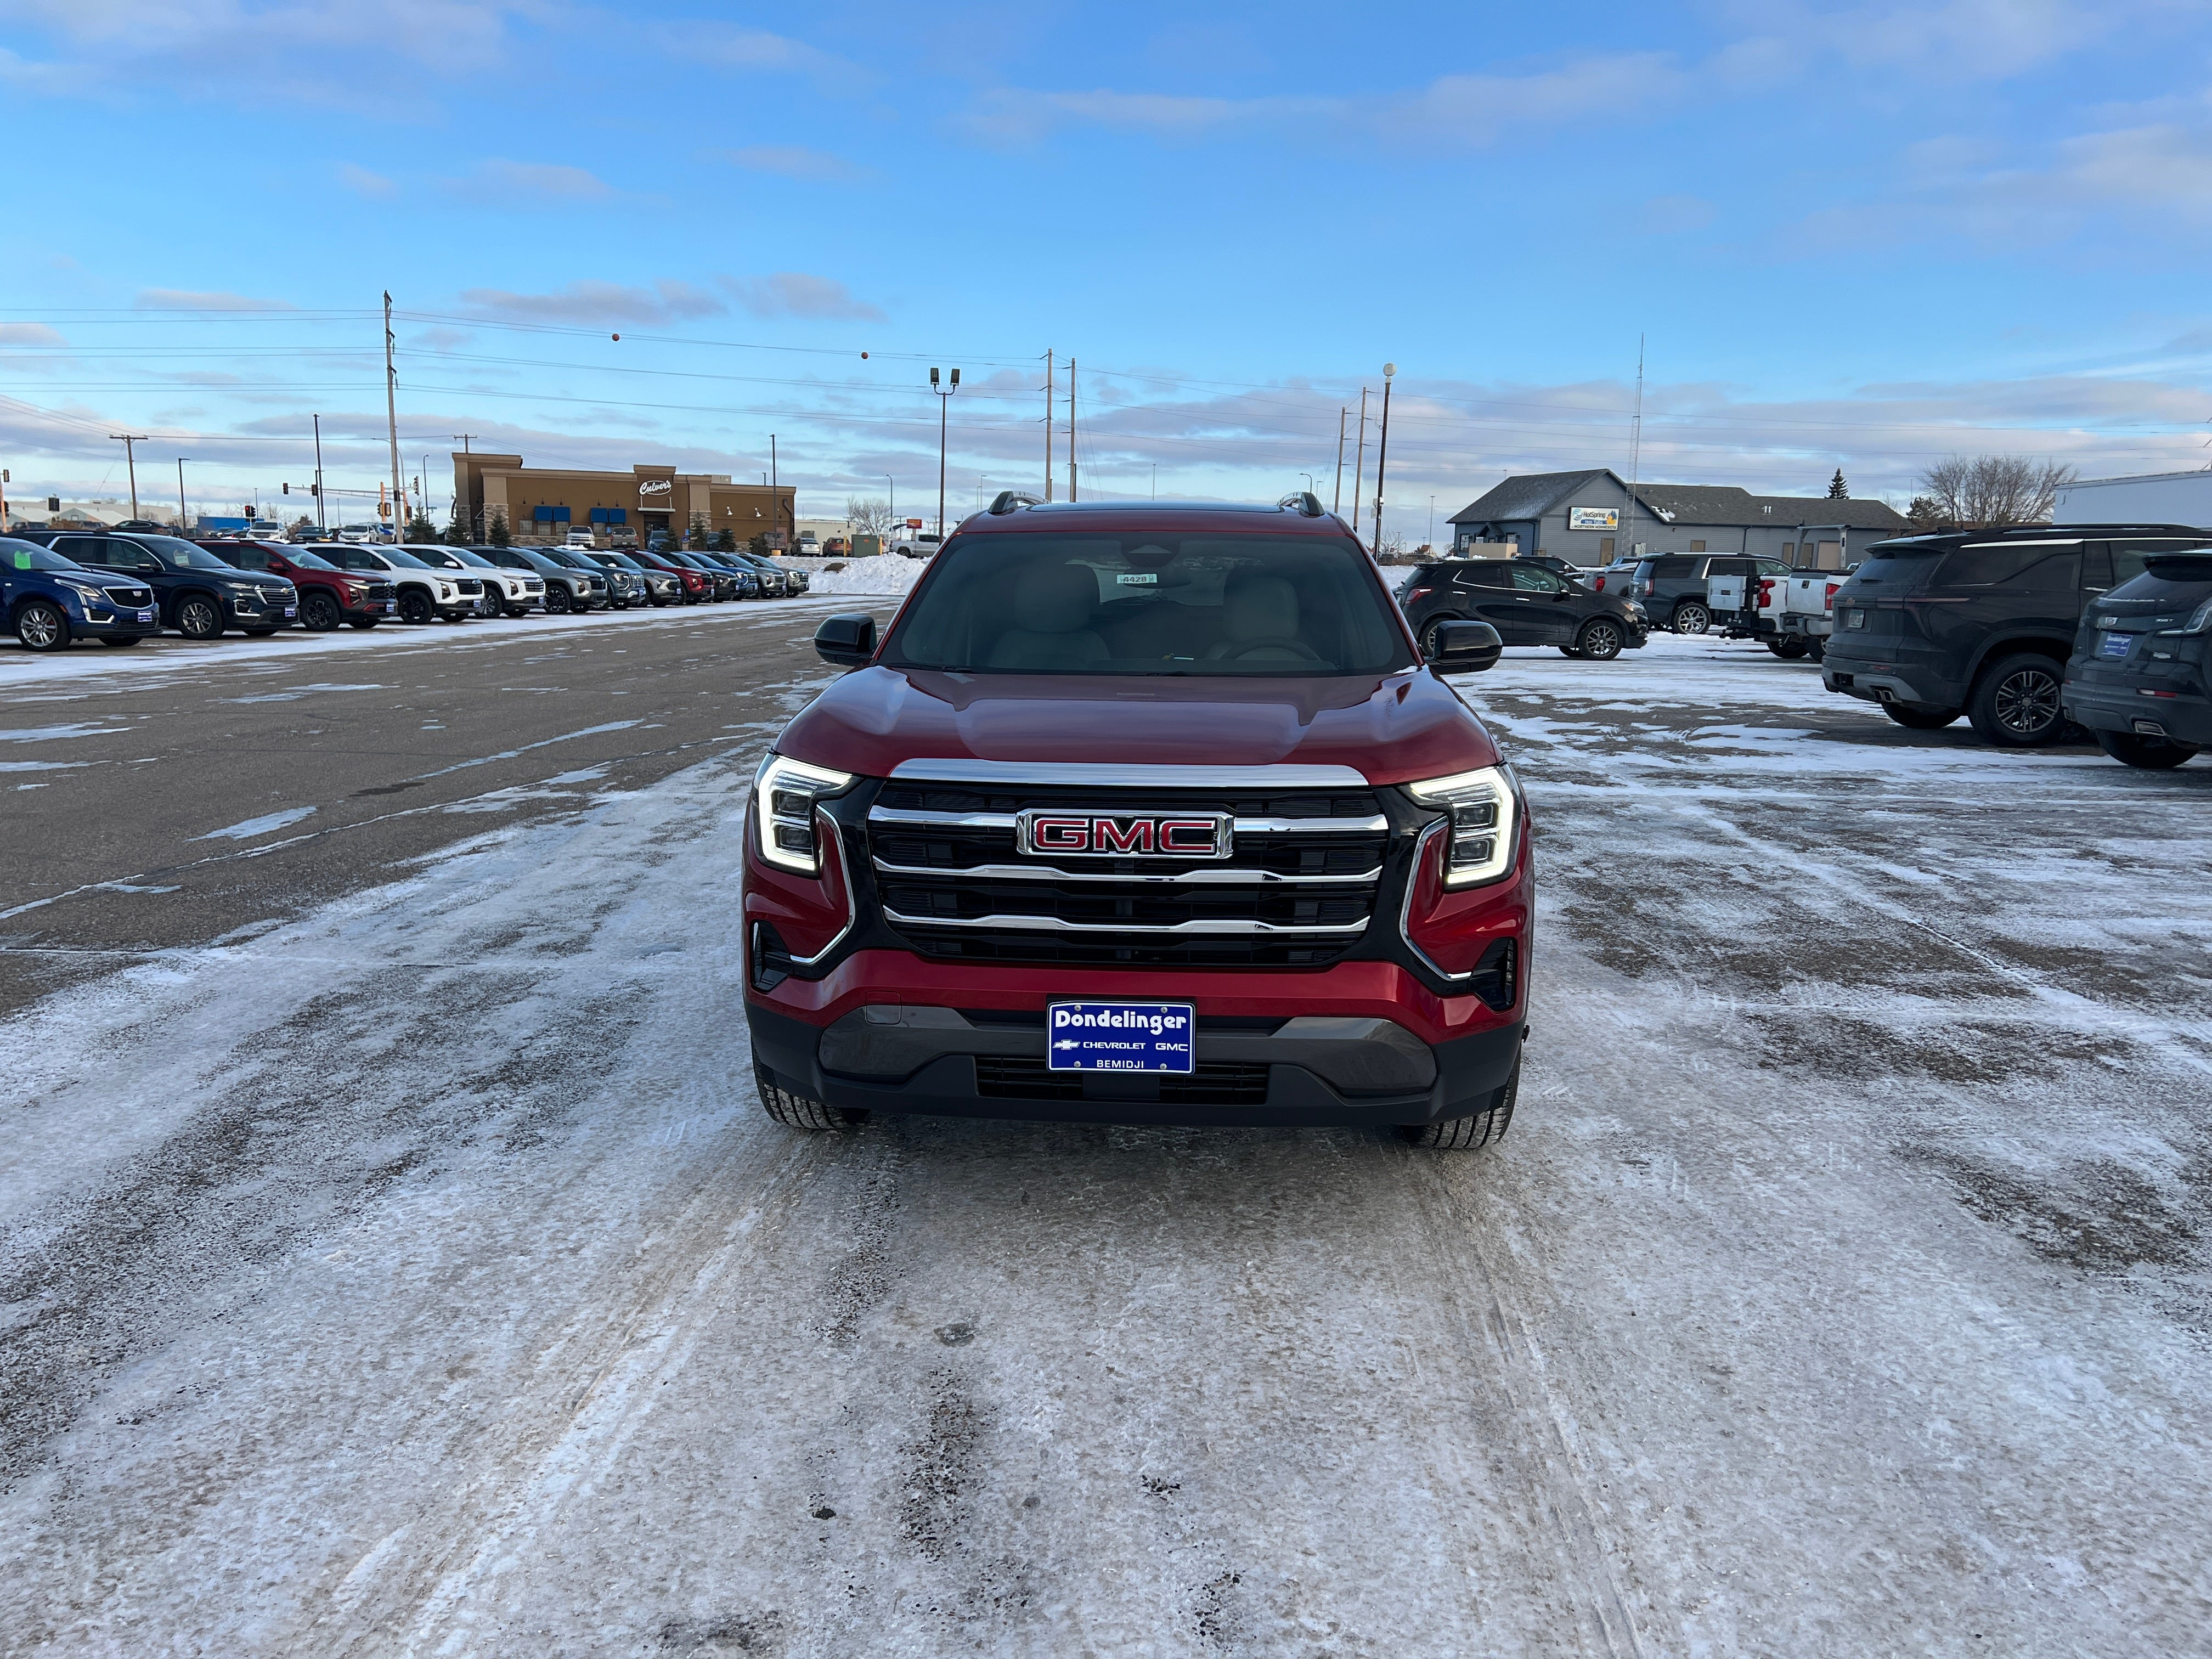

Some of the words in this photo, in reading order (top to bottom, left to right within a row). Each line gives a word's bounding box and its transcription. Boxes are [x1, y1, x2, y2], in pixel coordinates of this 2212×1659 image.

[639, 480, 672, 495] Culver's
[1034, 817, 1215, 853] GMC
[1055, 1010, 1187, 1035] Dondelinger
[1156, 1043, 1188, 1051] GMC
[1097, 1060, 1144, 1069] BEMIDJI
